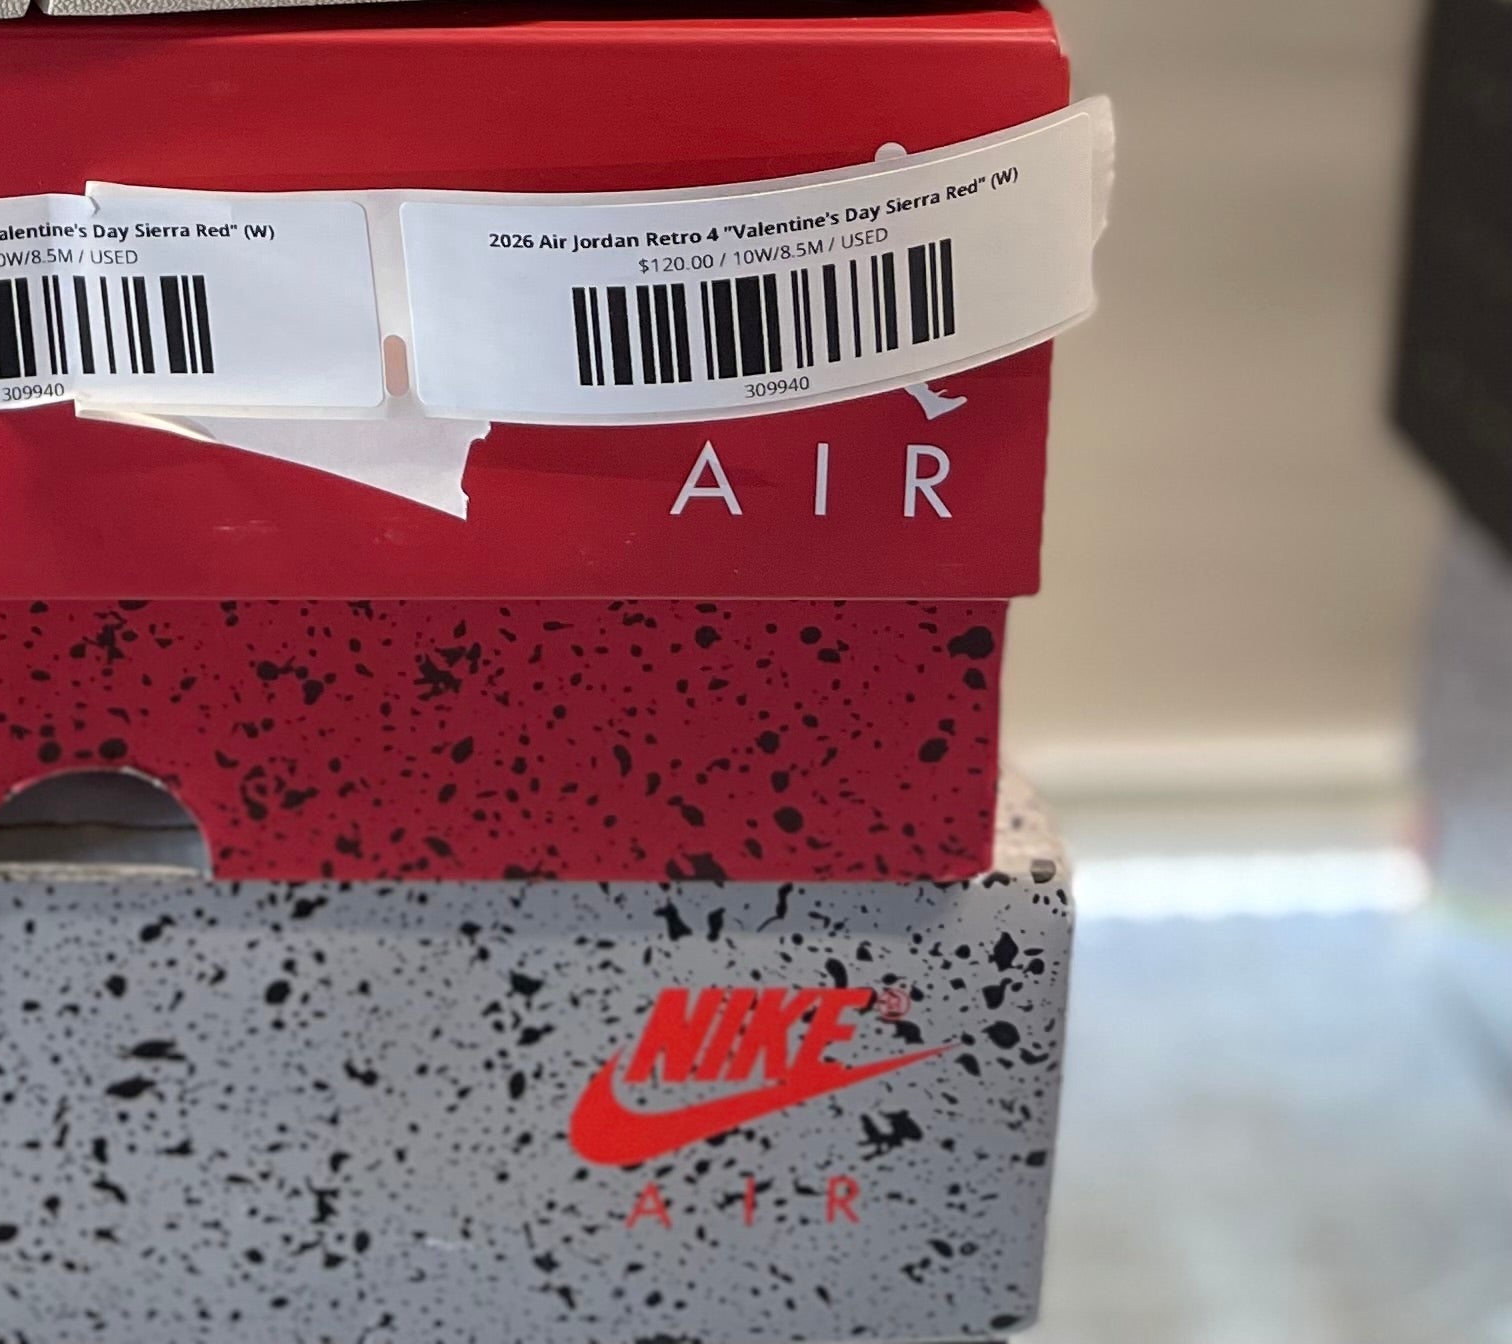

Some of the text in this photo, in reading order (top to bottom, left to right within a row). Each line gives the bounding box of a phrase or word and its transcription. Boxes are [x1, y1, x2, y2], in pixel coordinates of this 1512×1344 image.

[93, 224, 129, 243] Day
[135, 223, 190, 238] Sierra
[196, 223, 238, 238] Red"
[244, 224, 276, 241] (W)
[489, 233, 534, 249] 2026
[539, 234, 567, 249] Air
[571, 233, 639, 253] Jordan
[646, 230, 702, 246] Retro
[706, 227, 719, 242] 4
[845, 204, 881, 223] Day
[886, 191, 941, 214] Sierra
[946, 176, 987, 201] Red"
[991, 166, 1019, 191] (W)
[90, 249, 139, 265] USED
[638, 253, 714, 274] $120.00
[734, 238, 824, 266] 10W/8.5M
[841, 227, 888, 249] USED
[1, 383, 65, 403] 309940
[744, 376, 810, 399] 309940
[670, 439, 953, 518] AIR
[623, 987, 875, 1083] NIKE
[626, 1175, 861, 1230] AIR
